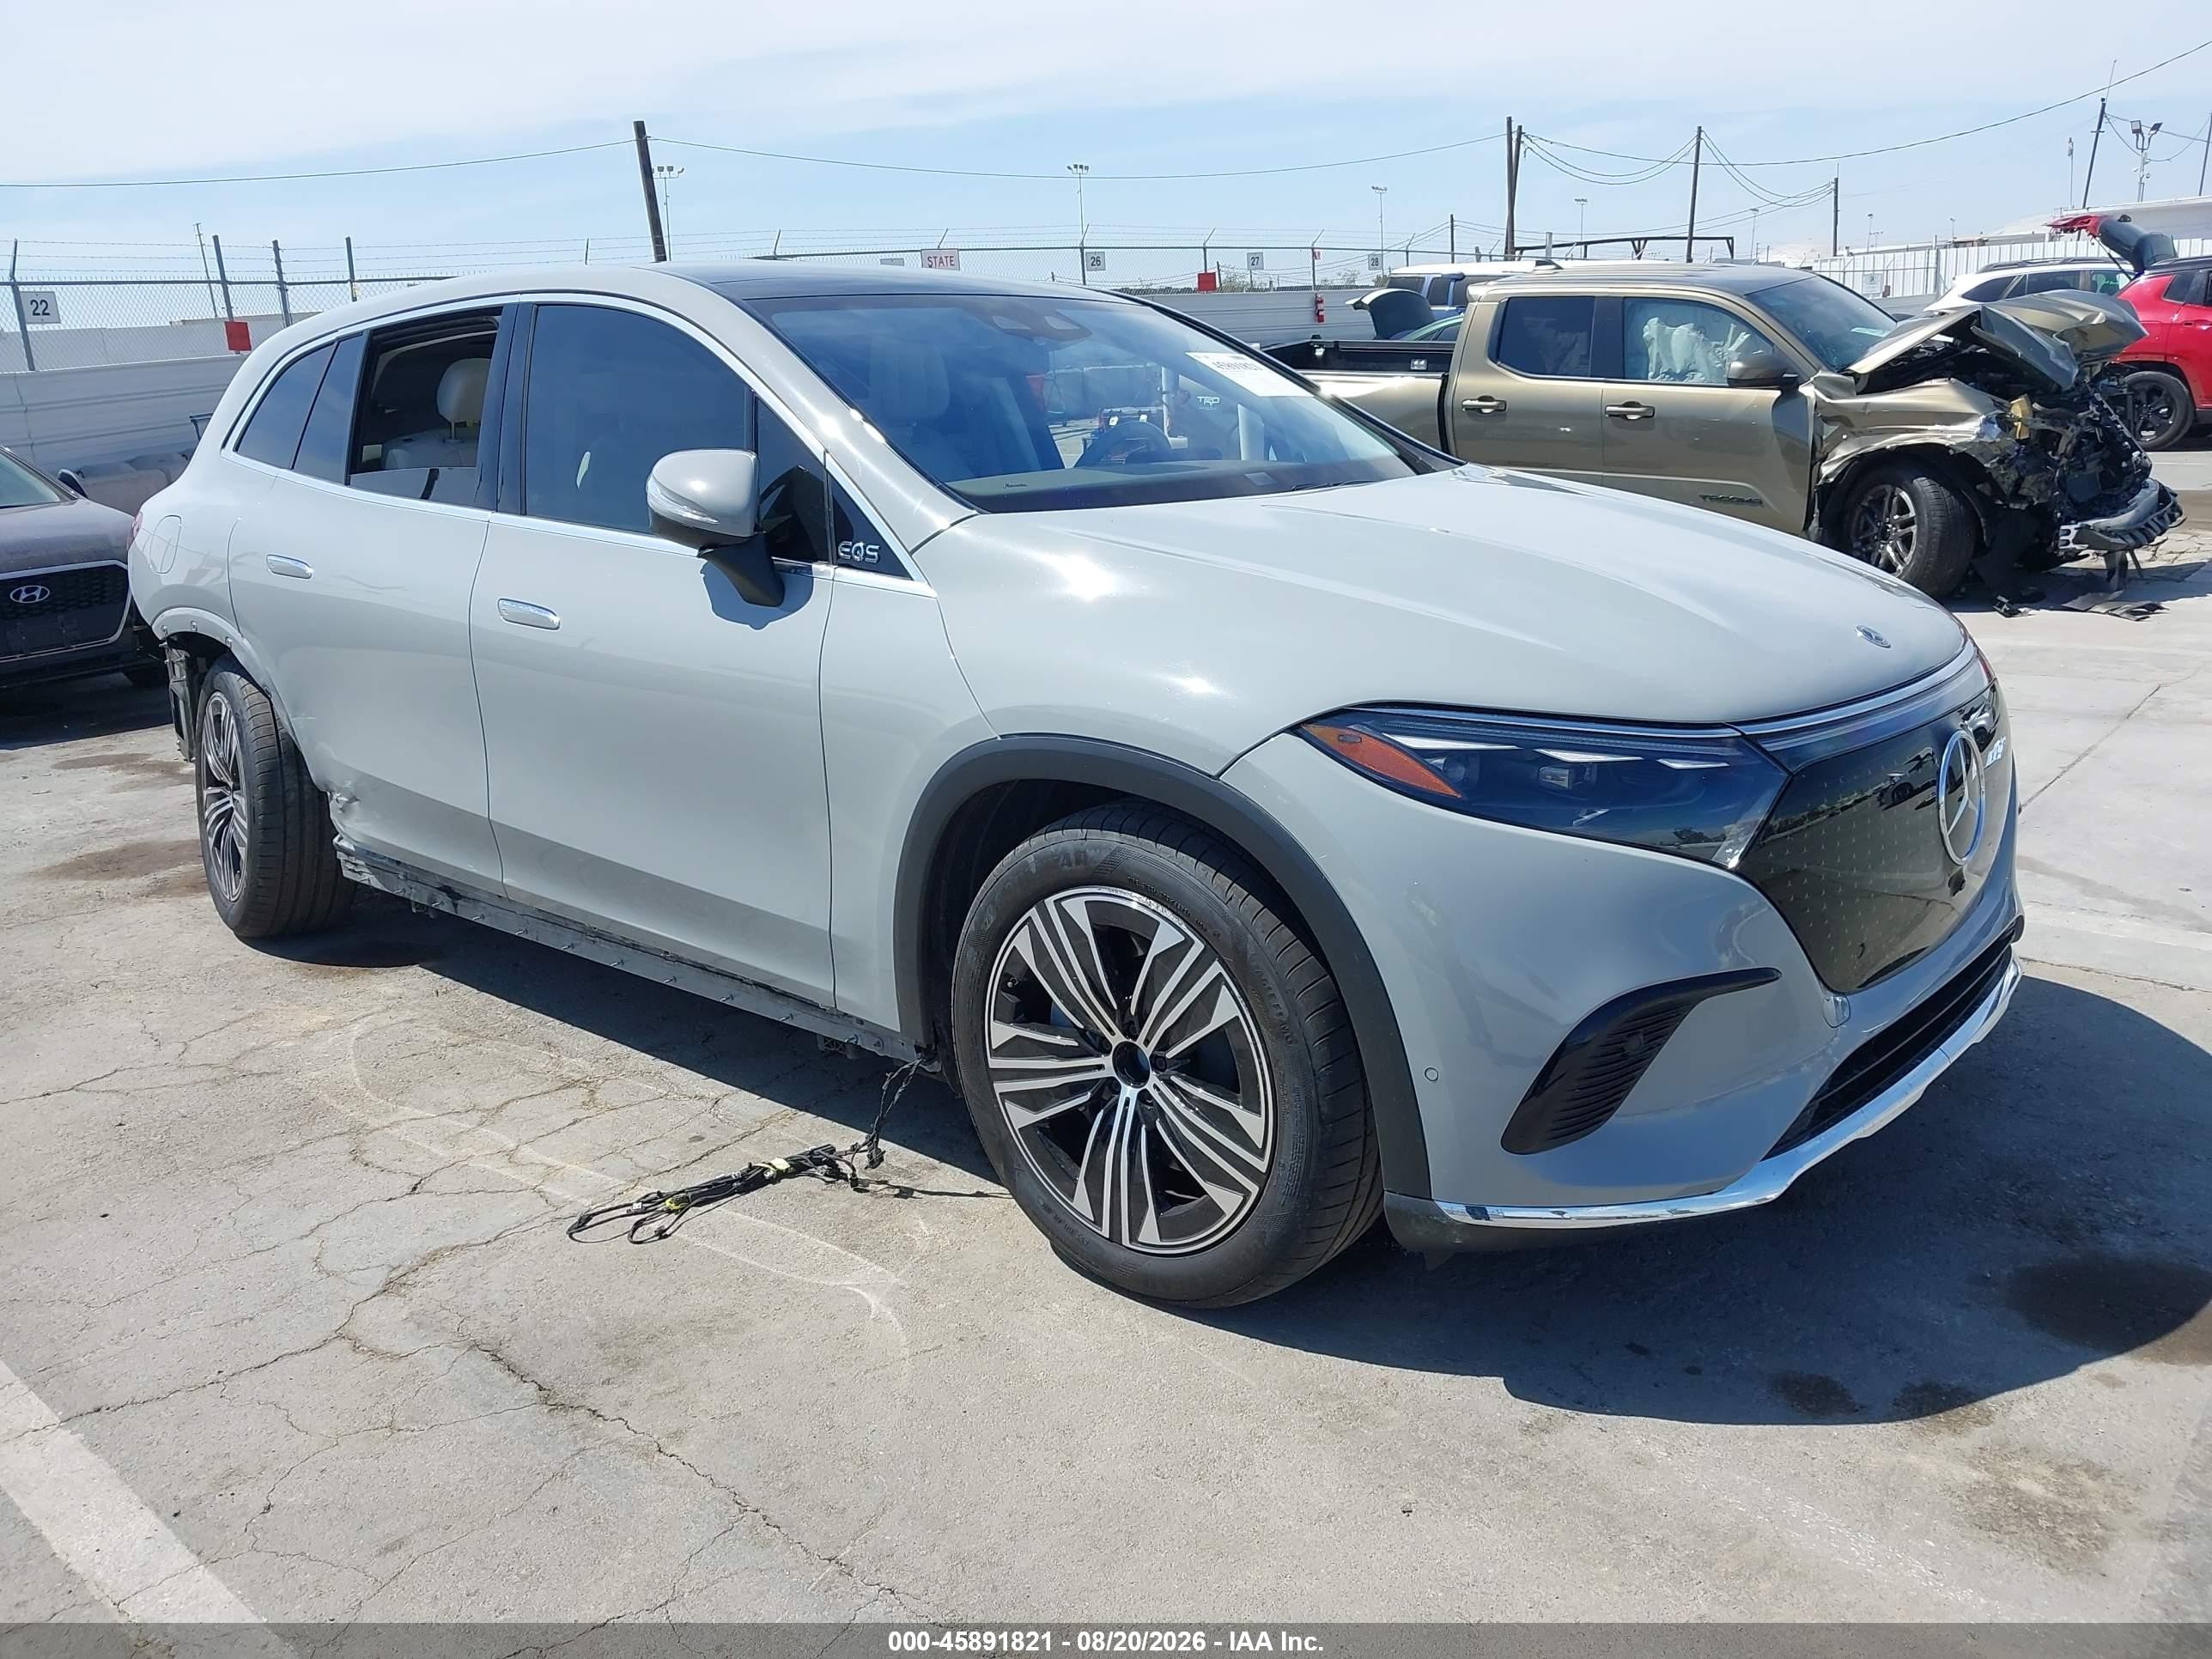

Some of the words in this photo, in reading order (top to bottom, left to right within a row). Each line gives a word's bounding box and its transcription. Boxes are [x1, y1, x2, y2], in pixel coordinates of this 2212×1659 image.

[927, 256, 955, 268] STATE
[1091, 256, 1102, 267] 26
[1250, 256, 1260, 266] 27
[1370, 258, 1379, 267] 28
[30, 299, 50, 316] 22
[1196, 396, 1220, 406] TRD
[838, 541, 880, 563] EQS
